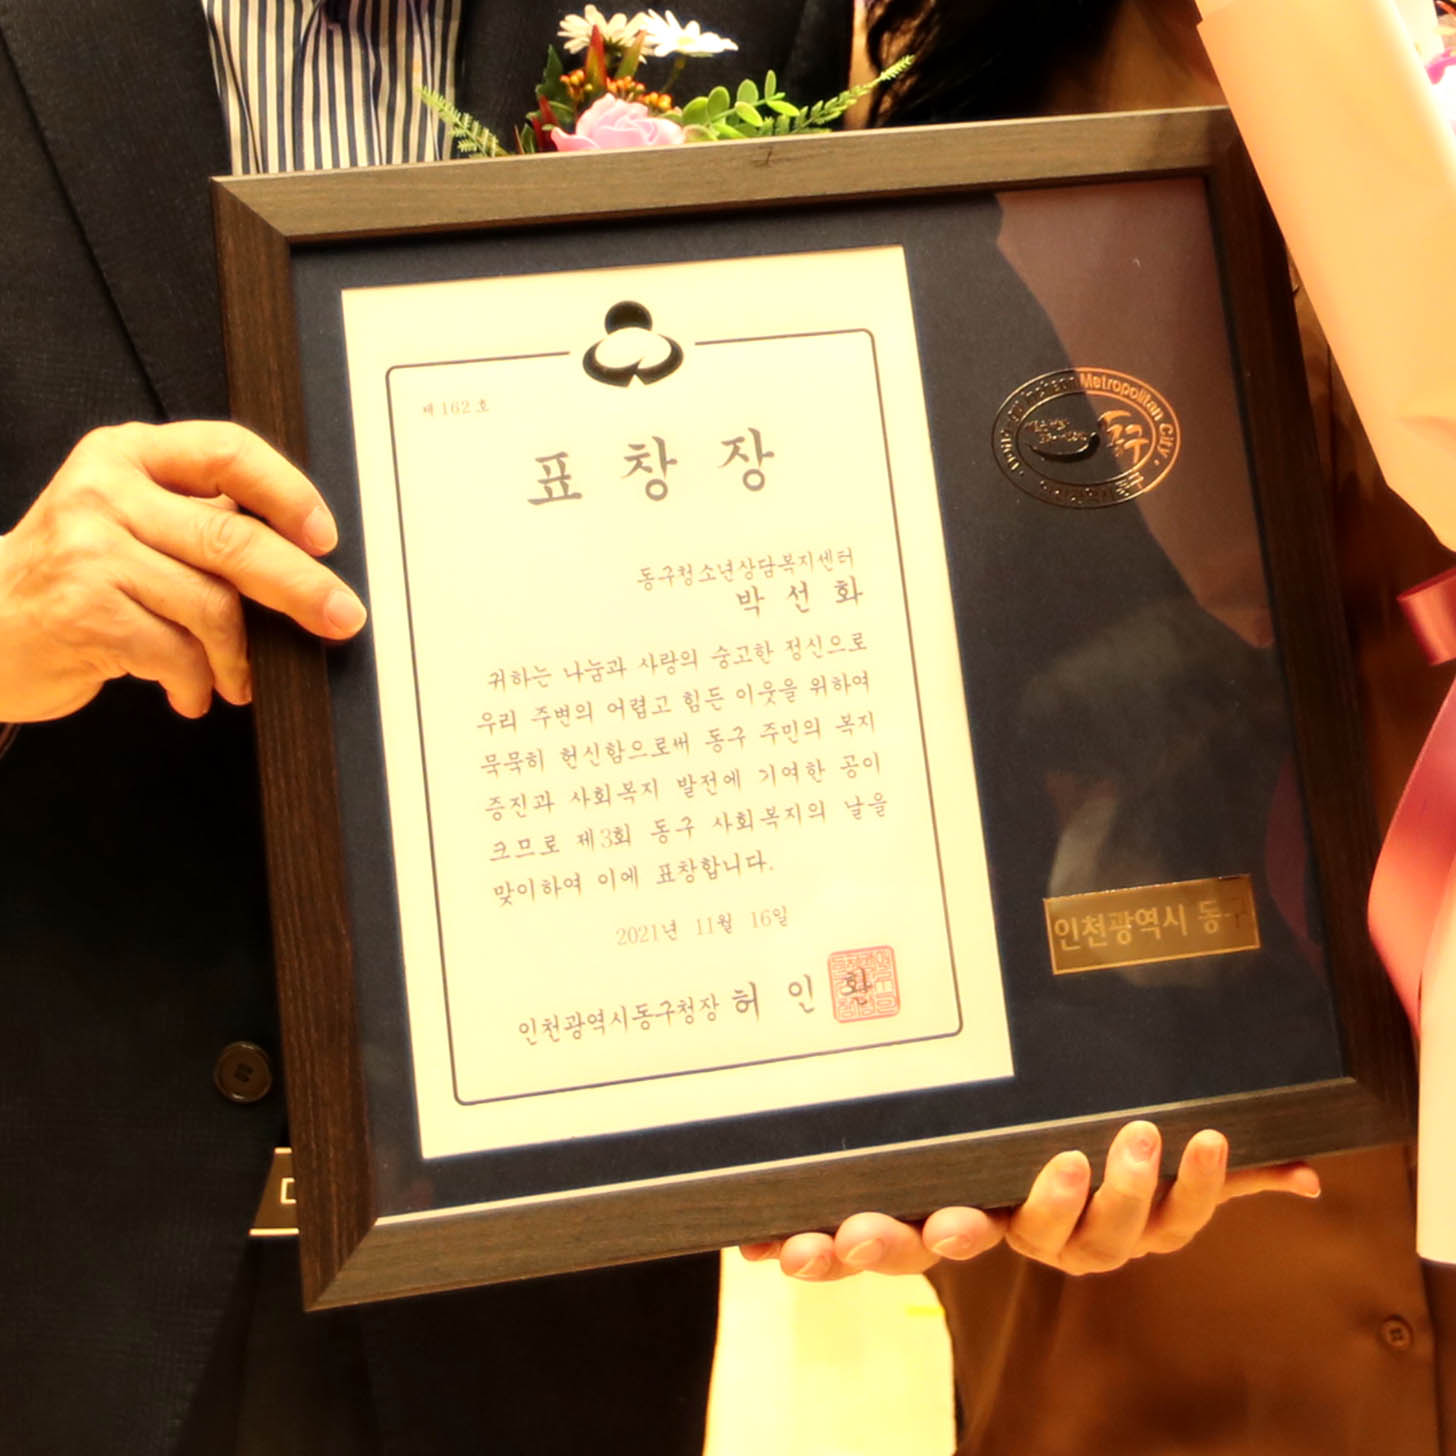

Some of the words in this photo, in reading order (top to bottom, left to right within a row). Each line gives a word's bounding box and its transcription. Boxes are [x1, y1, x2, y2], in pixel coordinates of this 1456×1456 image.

[1079, 373, 1166, 422] Metropolitan
[636, 546, 856, 592] 동구청소년상담복지센터
[487, 664, 553, 693] 귀하는
[562, 655, 628, 684] 나눔과
[639, 647, 699, 676] 사랑의
[711, 639, 775, 670] 숭고한
[785, 631, 868, 662] 정신으로
[476, 708, 518, 737] 우리
[530, 700, 593, 729] 주변의
[606, 694, 673, 721] 어렵고
[682, 686, 725, 714] 힘든
[735, 677, 798, 705] 이웃을
[809, 669, 870, 697] 위하여
[480, 747, 545, 779] 묵묵히
[559, 731, 690, 771] 헌신함으로써
[704, 725, 747, 754] 동구
[759, 716, 822, 745] 주민의
[834, 710, 876, 737] 복지
[484, 789, 556, 822] 증진과
[570, 777, 659, 809] 사회복지
[676, 767, 742, 800] 발전에
[758, 757, 826, 787] 기여한
[839, 751, 881, 780] 공이
[488, 833, 561, 862] 크므로
[576, 823, 632, 852] 제3회
[650, 815, 696, 845] 동구
[712, 799, 826, 833] 사회복지의
[843, 791, 889, 821] 날을
[492, 871, 583, 908] 맞이하여
[597, 864, 640, 892] 이에
[655, 849, 774, 885] 표창합니다.
[615, 919, 678, 946] 2021년
[696, 911, 733, 936] 11월
[751, 904, 788, 929] 16일
[1053, 903, 1188, 952] 인천광역시
[518, 992, 721, 1047] 인천광역시동구청장
